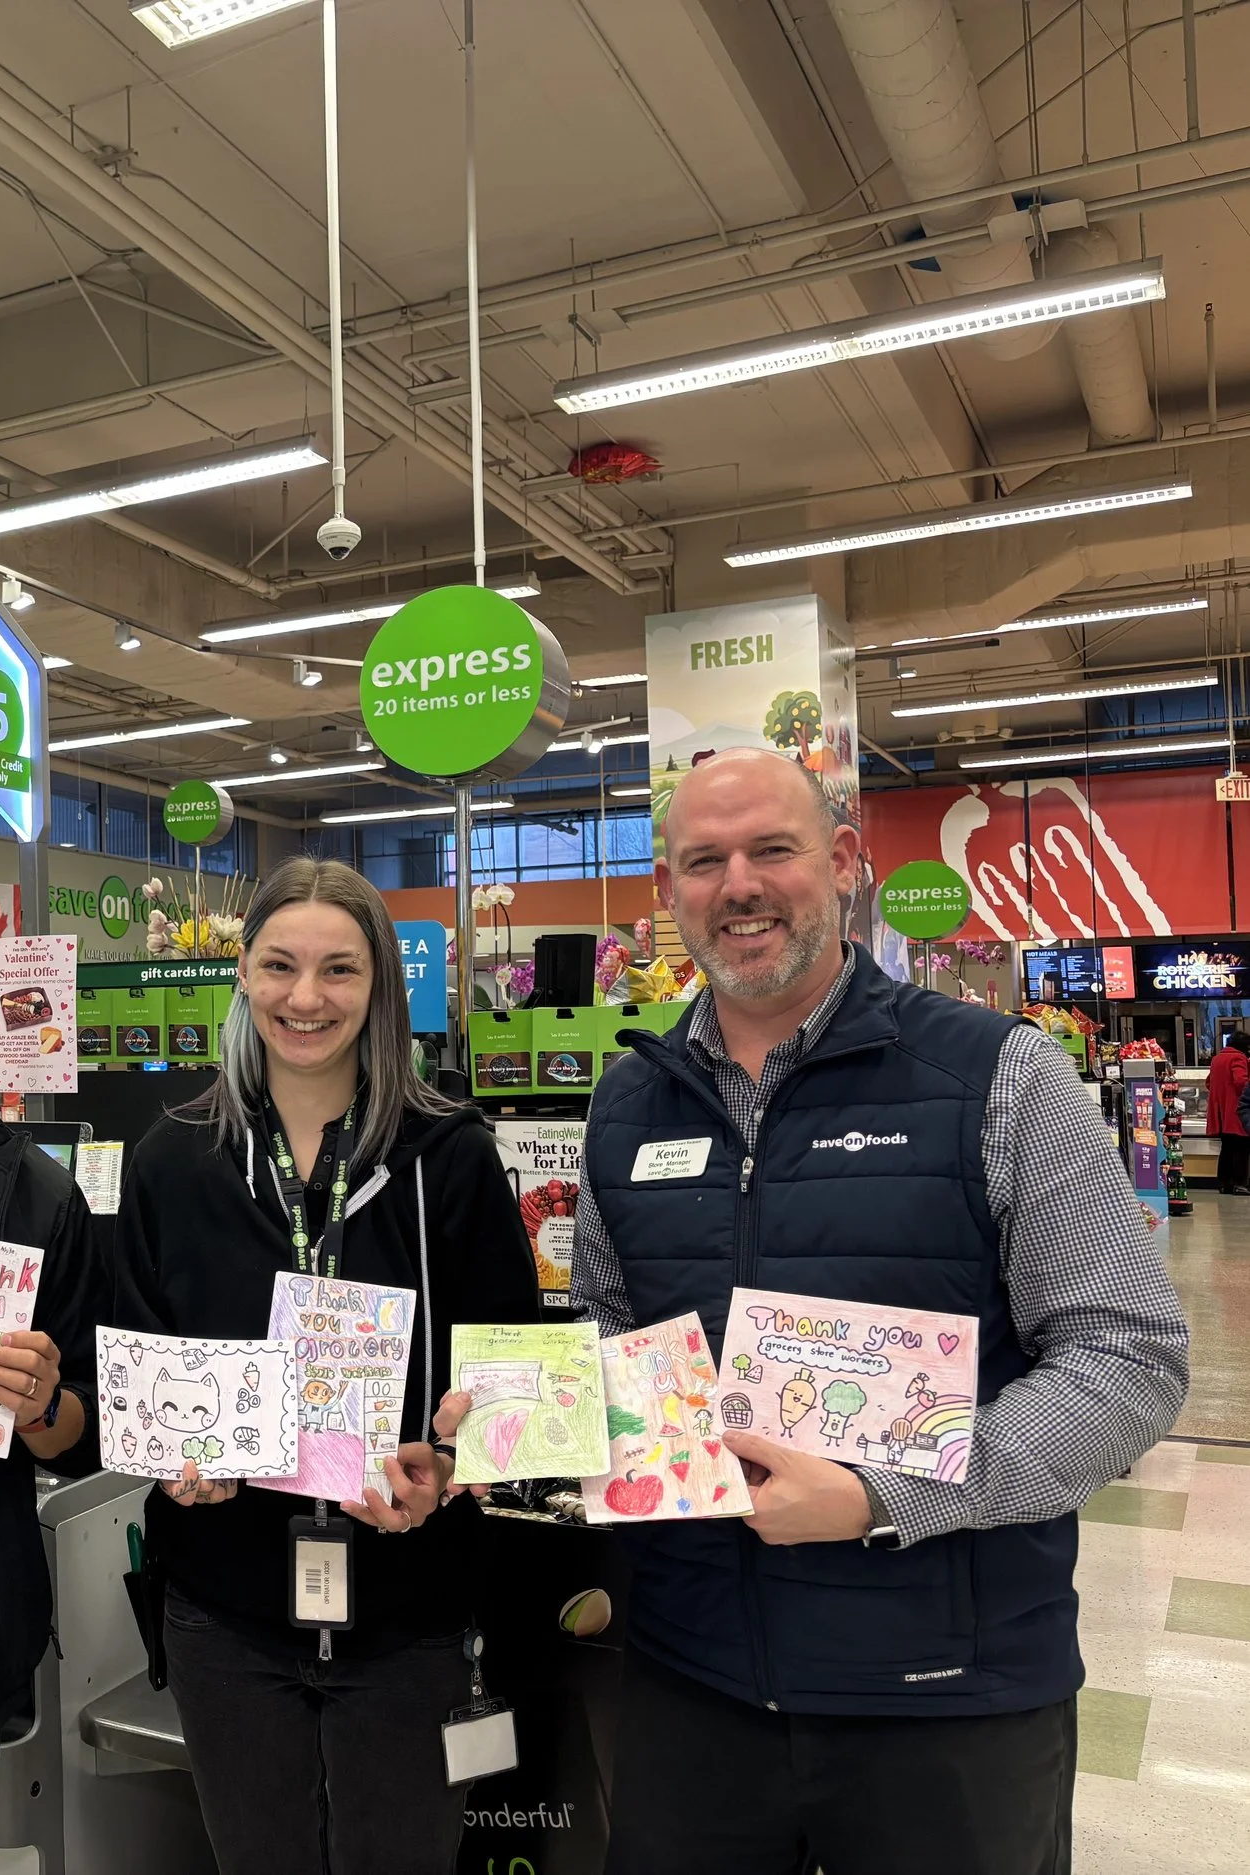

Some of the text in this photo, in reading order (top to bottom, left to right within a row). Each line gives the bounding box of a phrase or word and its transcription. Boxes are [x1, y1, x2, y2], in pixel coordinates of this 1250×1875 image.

[690, 634, 773, 671] FRESH
[371, 644, 531, 691] express
[374, 685, 531, 716] 20 items or less
[167, 801, 216, 815] express
[885, 886, 962, 904] express
[103, 895, 130, 921] on
[887, 905, 898, 913] 20
[901, 904, 927, 912] items
[5, 953, 54, 963] Valentine's
[0, 967, 59, 980] Special Offer
[141, 968, 161, 981] gift
[164, 967, 196, 977] cards
[199, 966, 217, 976] for
[1153, 974, 1236, 989] CHICKEN
[538, 1127, 582, 1141] EatingWell
[516, 1141, 577, 1154] What to
[656, 1148, 688, 1160] Kevin
[534, 1155, 581, 1169] for Lif
[289, 1277, 365, 1313] Thank
[546, 1296, 567, 1305] SPC
[746, 1306, 922, 1351] Thank you
[764, 1341, 883, 1368] grocery store workers
